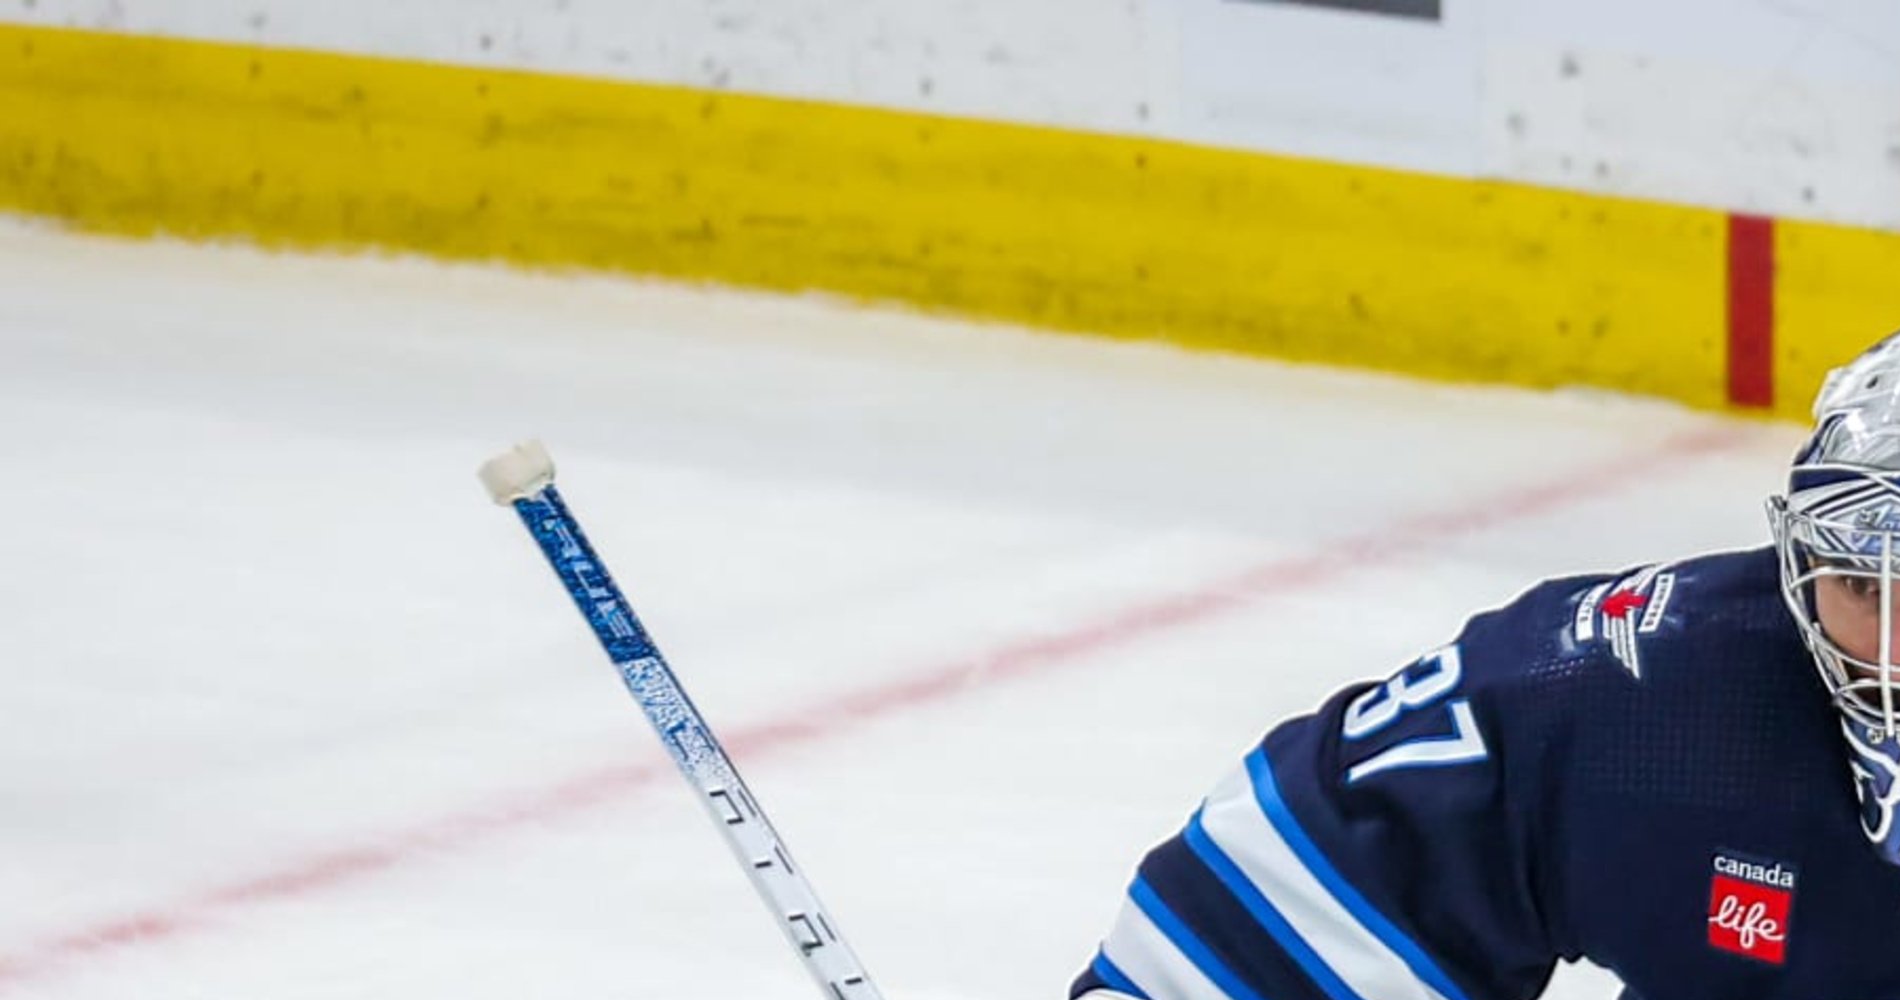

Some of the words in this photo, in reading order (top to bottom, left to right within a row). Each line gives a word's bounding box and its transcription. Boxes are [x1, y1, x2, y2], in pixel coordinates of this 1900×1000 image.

[1343, 644, 1488, 784] 37
[1714, 855, 1794, 888] canada
[1708, 894, 1785, 949] life
